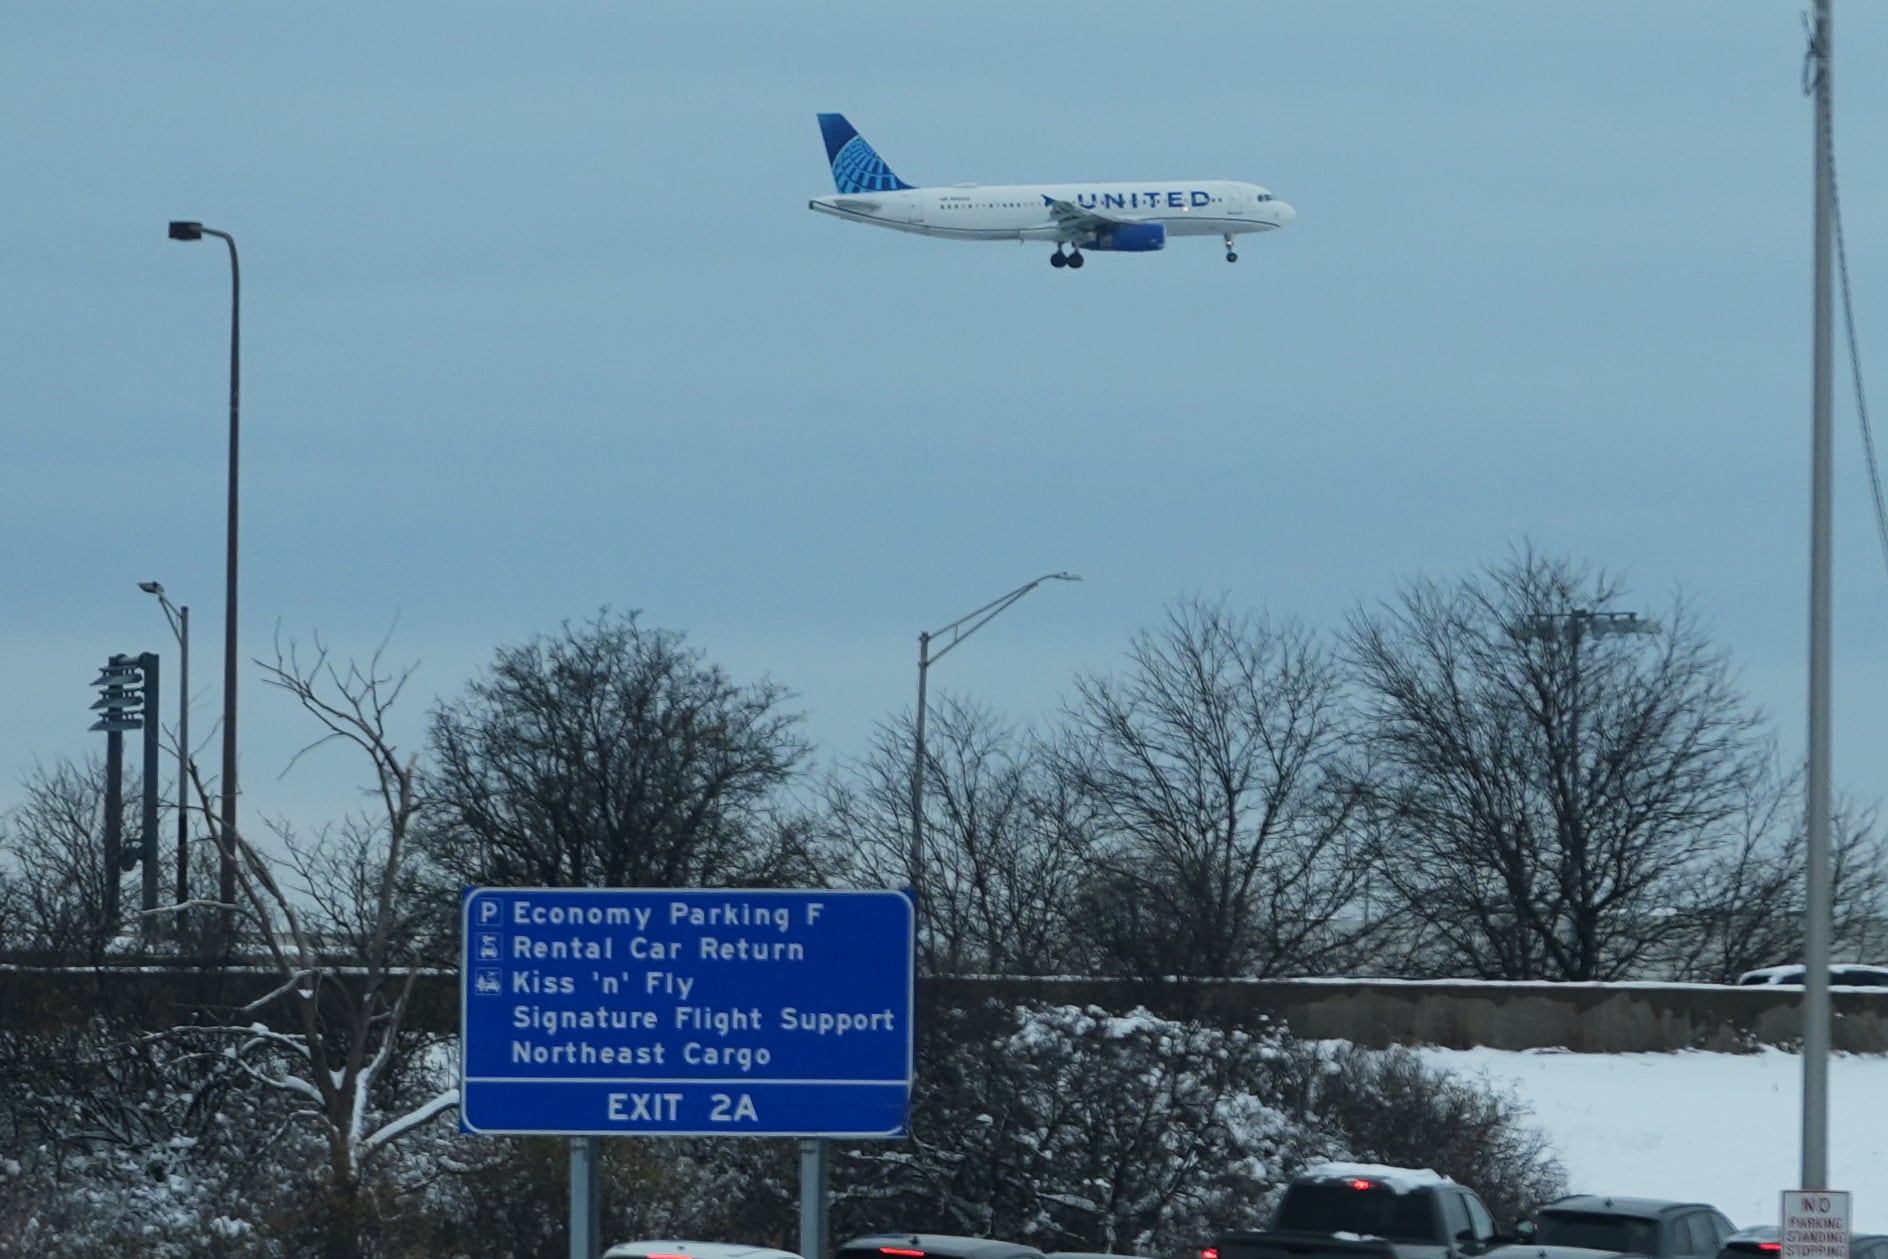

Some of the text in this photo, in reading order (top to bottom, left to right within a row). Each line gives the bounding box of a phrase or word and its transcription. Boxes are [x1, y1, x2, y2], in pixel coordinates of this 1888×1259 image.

[1077, 190, 1211, 210] UNITED
[514, 901, 651, 930] Economy
[671, 902, 789, 932] Parking
[808, 902, 824, 925] F
[514, 935, 804, 961] Rental Car Return
[513, 970, 694, 1000] Kiss 'n' Fly
[514, 1005, 894, 1036] Signature Flight Support
[513, 1041, 771, 1071] Northeast Cargo
[608, 1093, 758, 1122] EXIT 2A
[1802, 1197, 1831, 1214] NO
[1789, 1217, 1843, 1229] PARKING
[1786, 1231, 1848, 1243] STANDING
[1786, 1245, 1848, 1258] STOPPING
